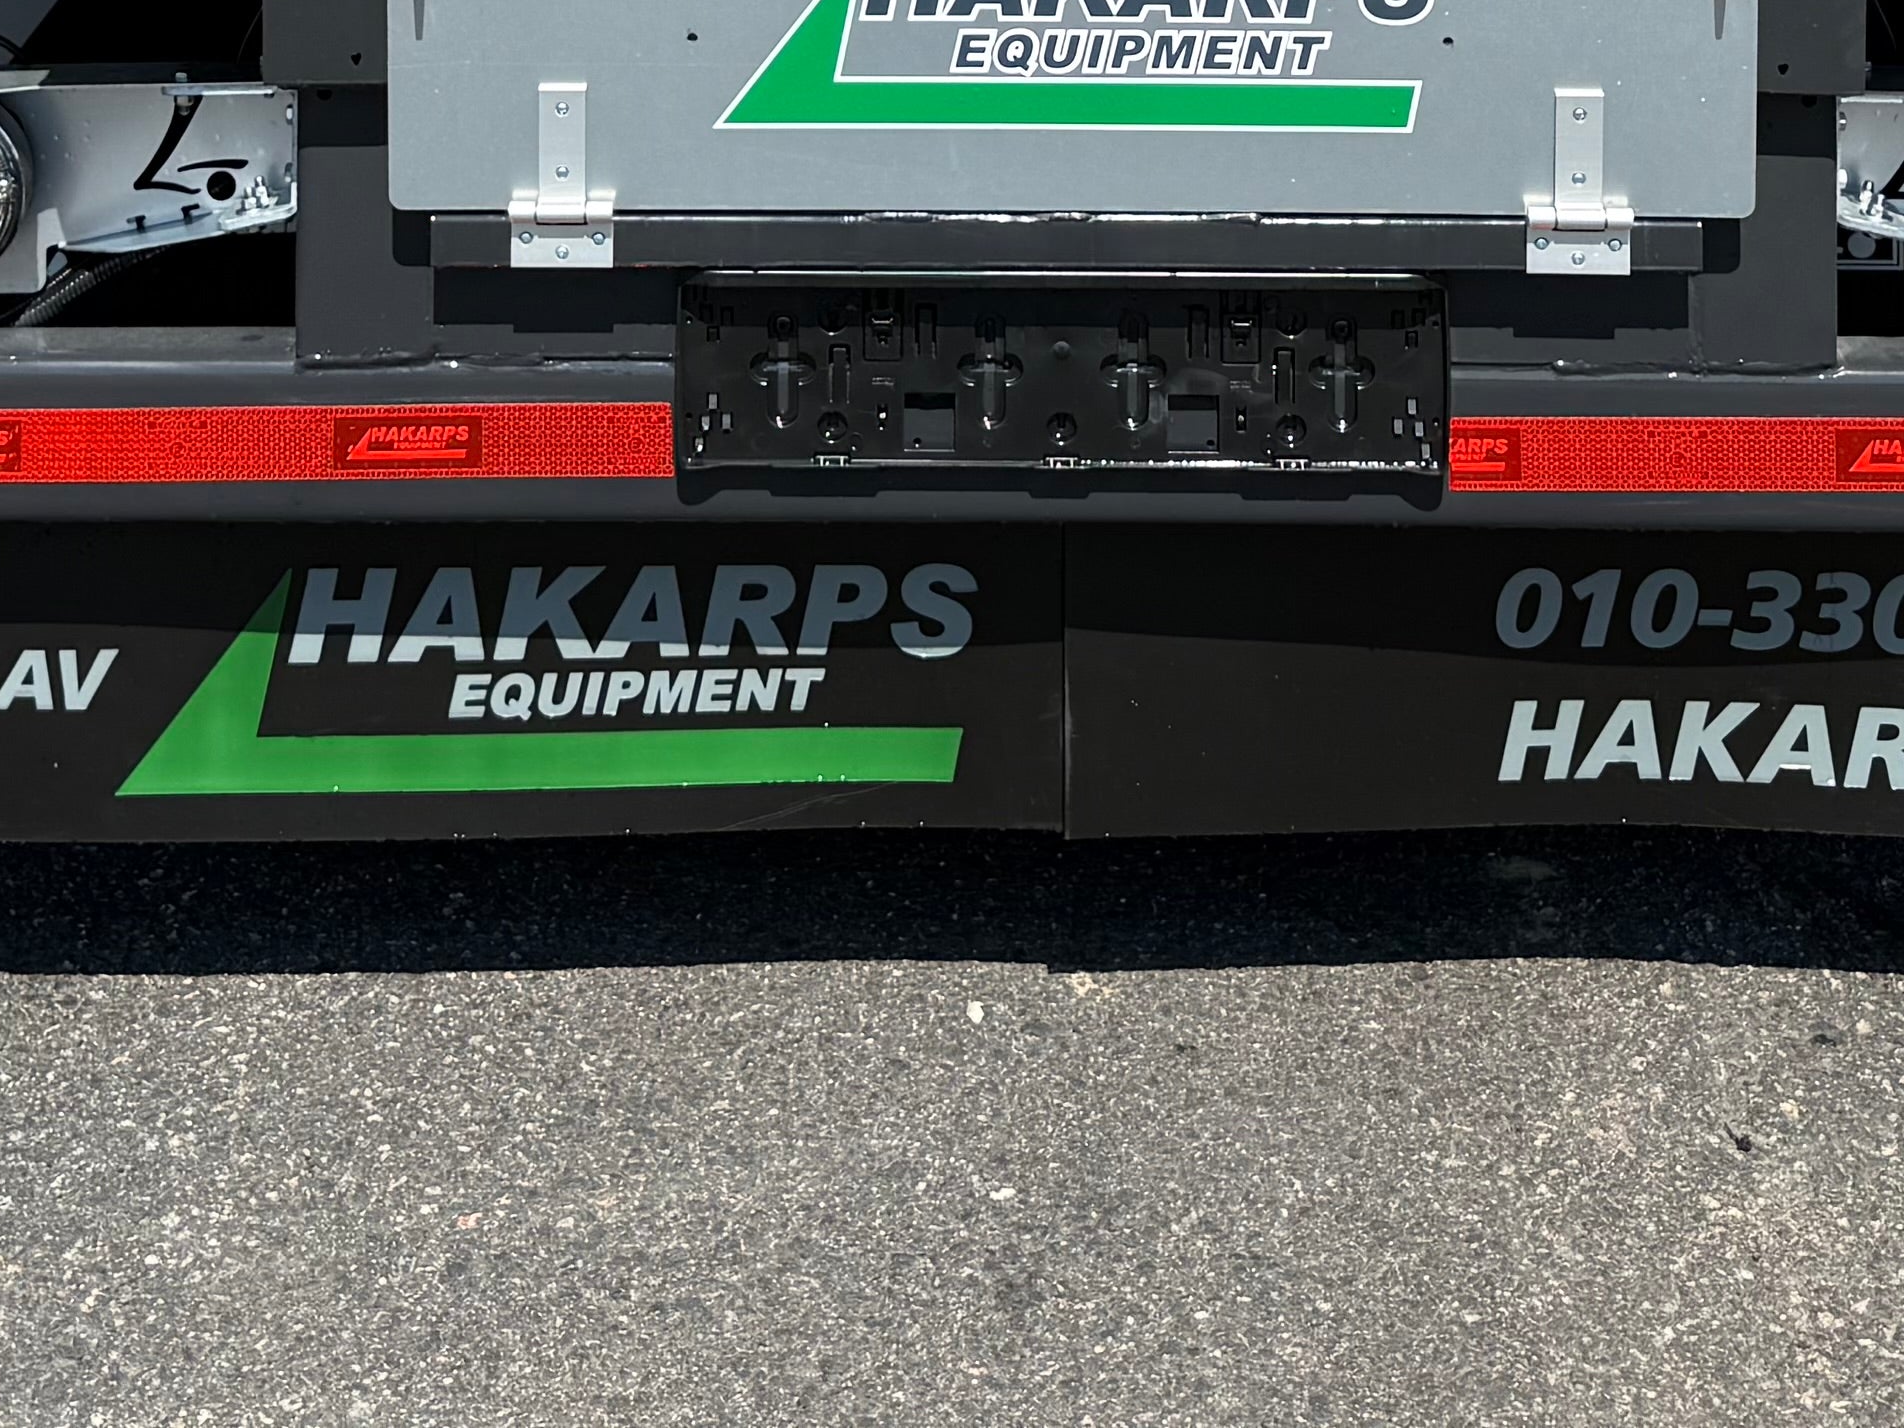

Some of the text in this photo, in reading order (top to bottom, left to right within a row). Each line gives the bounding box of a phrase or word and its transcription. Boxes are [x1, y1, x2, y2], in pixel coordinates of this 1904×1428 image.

[949, 28, 1332, 77] EQUIPMENT
[371, 425, 469, 442] HAKARPS
[1449, 438, 1508, 454] ARPS
[287, 562, 980, 663] HAKARPS
[448, 667, 826, 721] EQUIPMENT
